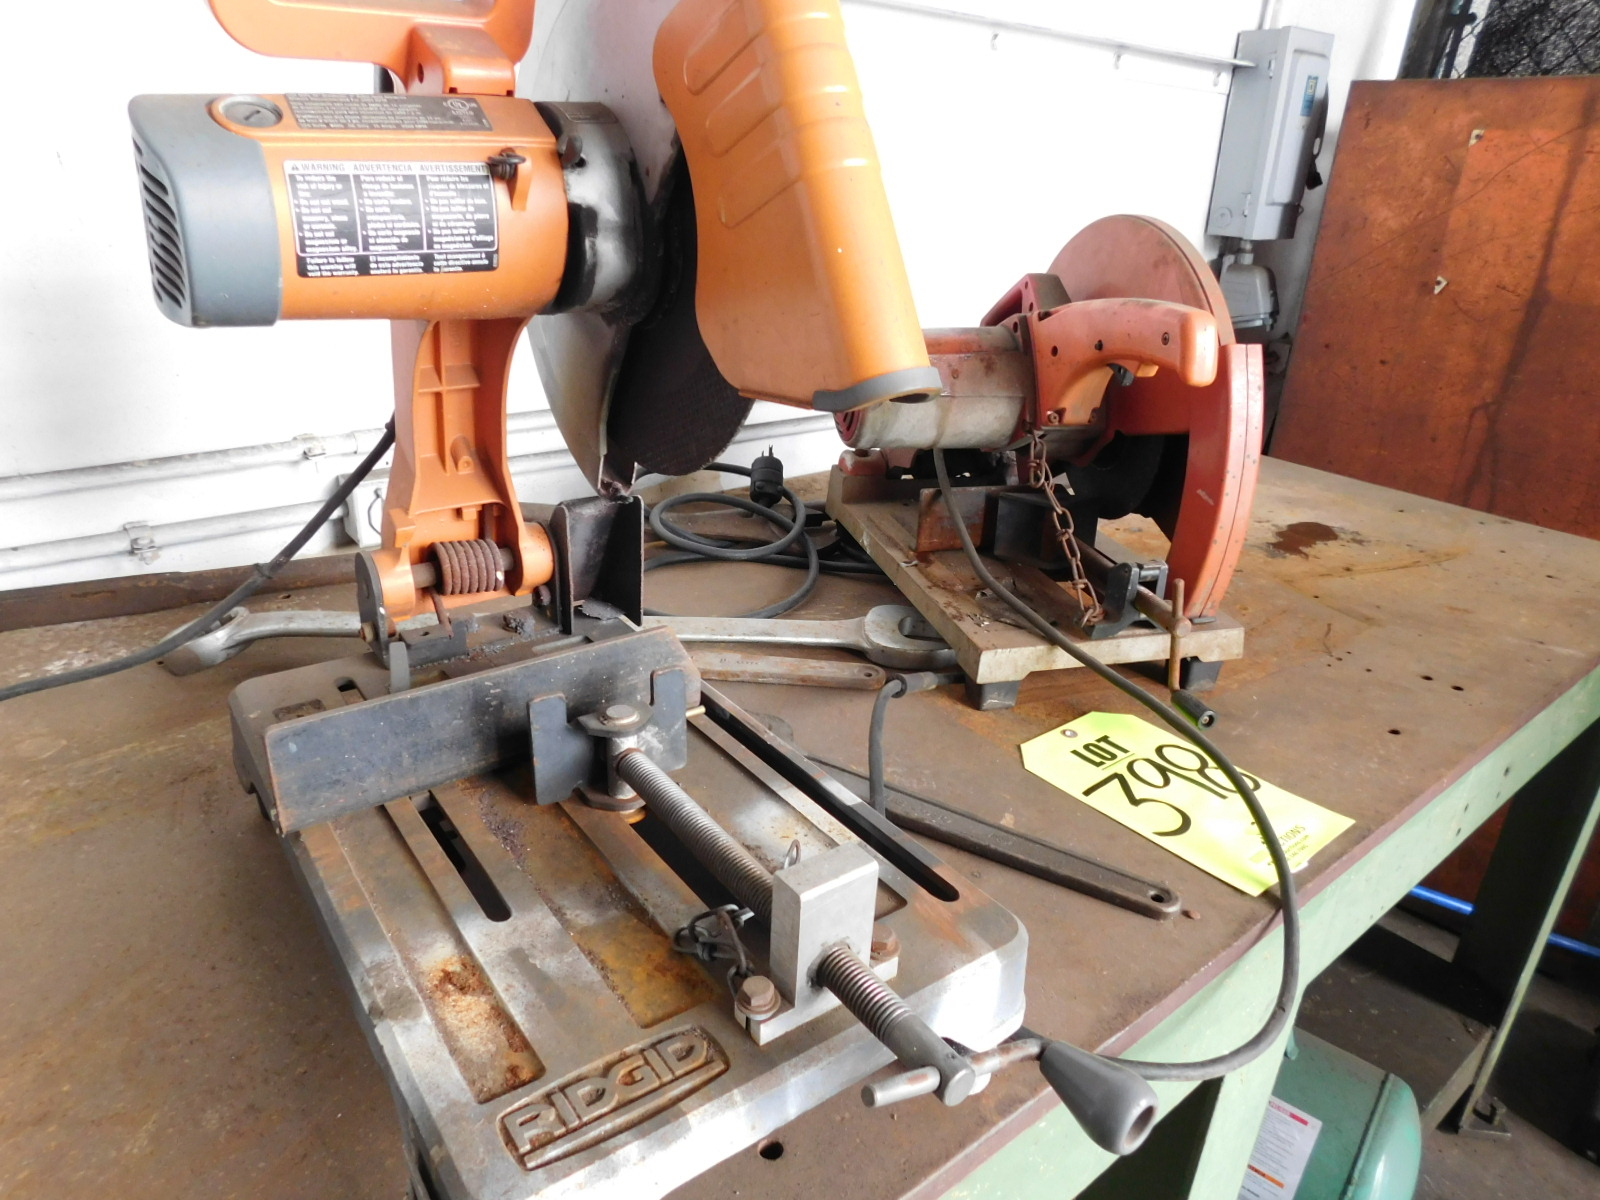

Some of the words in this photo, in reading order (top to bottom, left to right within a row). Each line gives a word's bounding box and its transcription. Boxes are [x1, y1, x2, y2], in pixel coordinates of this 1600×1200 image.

[301, 163, 346, 172] WARNING
[353, 163, 413, 172] ADVERTENCIA
[1070, 734, 1131, 768] LOT
[1082, 744, 1261, 837] 398
[500, 1027, 714, 1156] RIDGID
